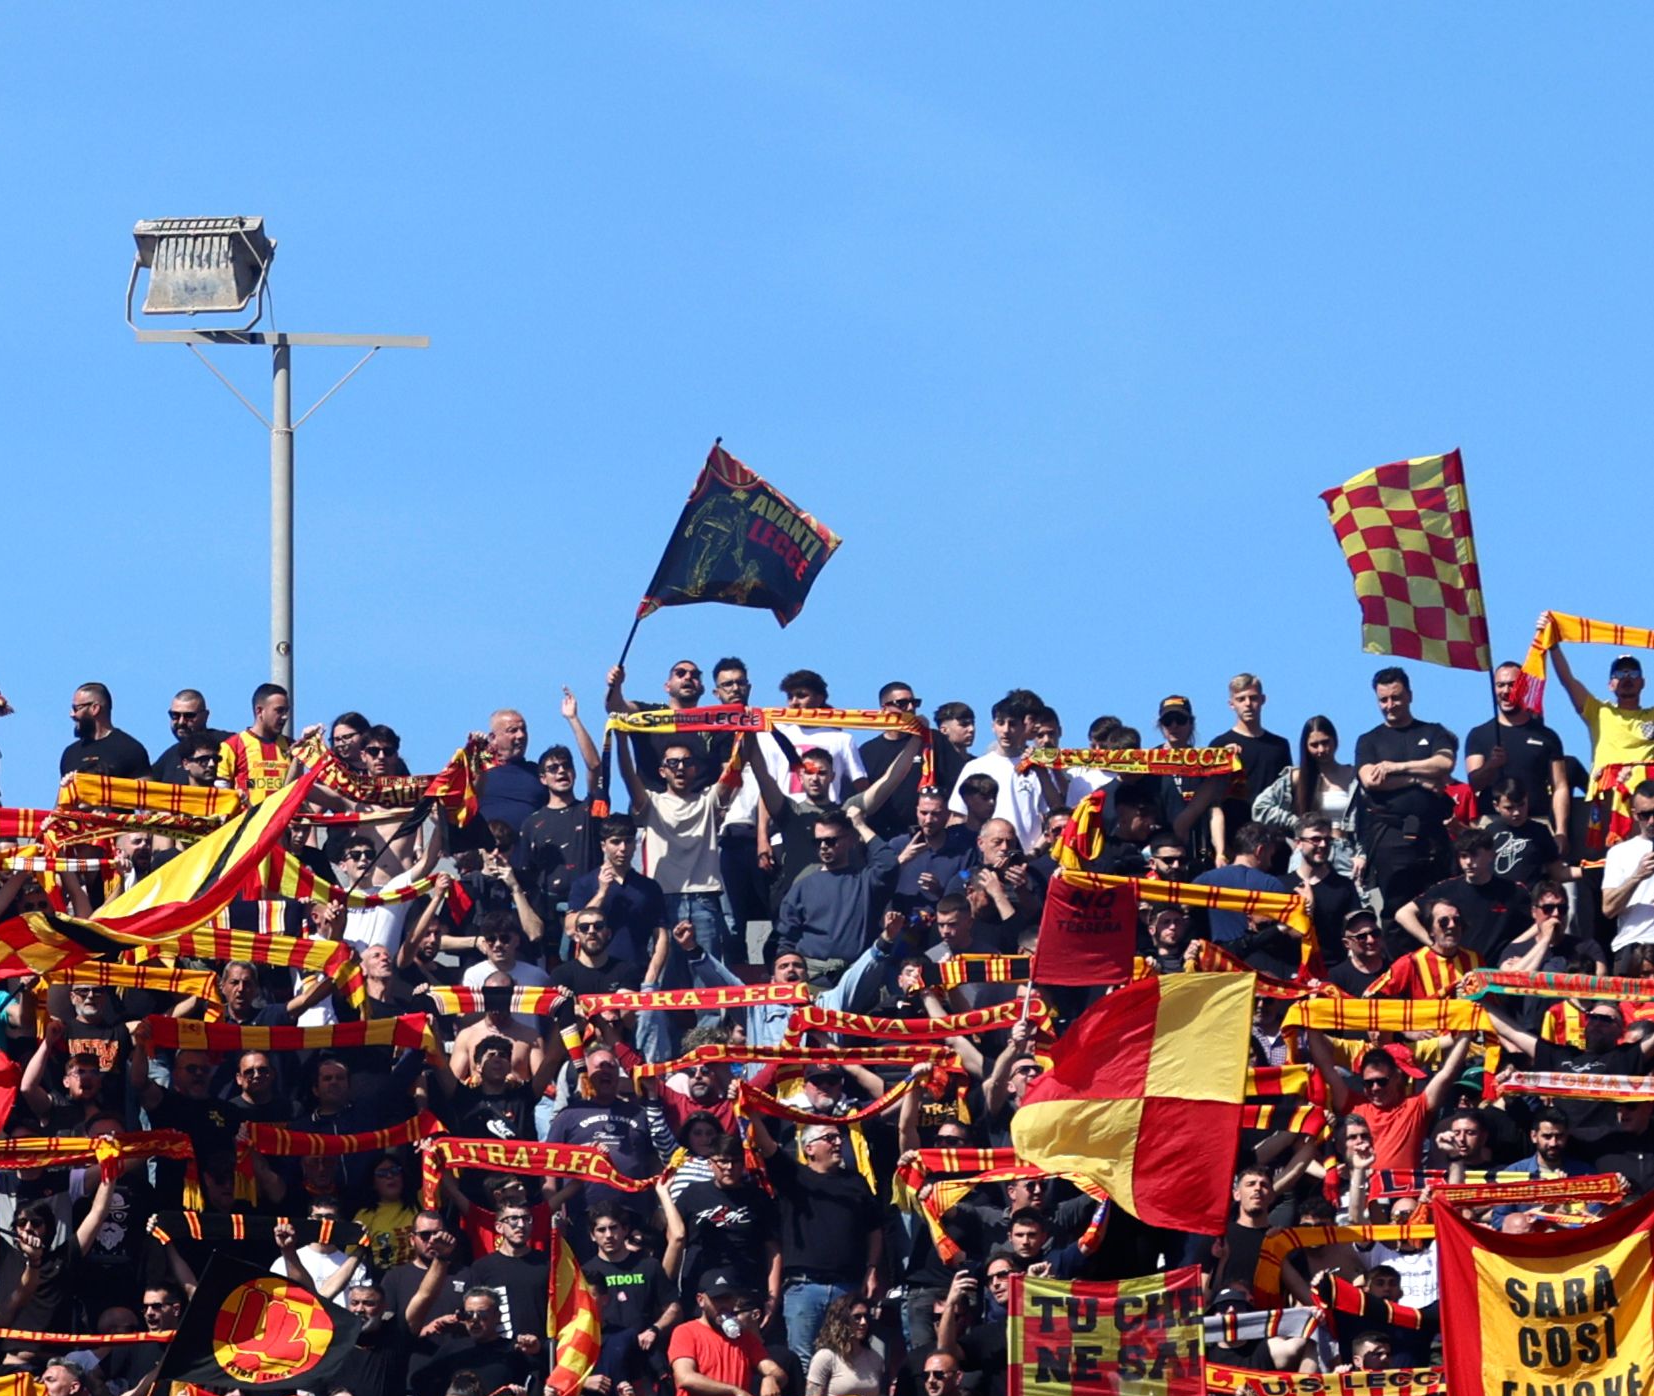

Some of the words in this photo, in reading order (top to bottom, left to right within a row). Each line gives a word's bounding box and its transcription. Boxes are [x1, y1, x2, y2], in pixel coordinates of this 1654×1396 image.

[748, 493, 824, 561] AVANTI
[749, 519, 810, 581] LECCE
[1150, 745, 1232, 766] LECCE
[927, 998, 1050, 1034] NORD
[1030, 1295, 1098, 1334] TU
[1114, 1286, 1205, 1332] CHE
[1504, 1263, 1620, 1320] SARÀ
[1034, 1345, 1104, 1384] NE
[1112, 1339, 1202, 1381] SAI
[1518, 1312, 1620, 1368] COSÌ
